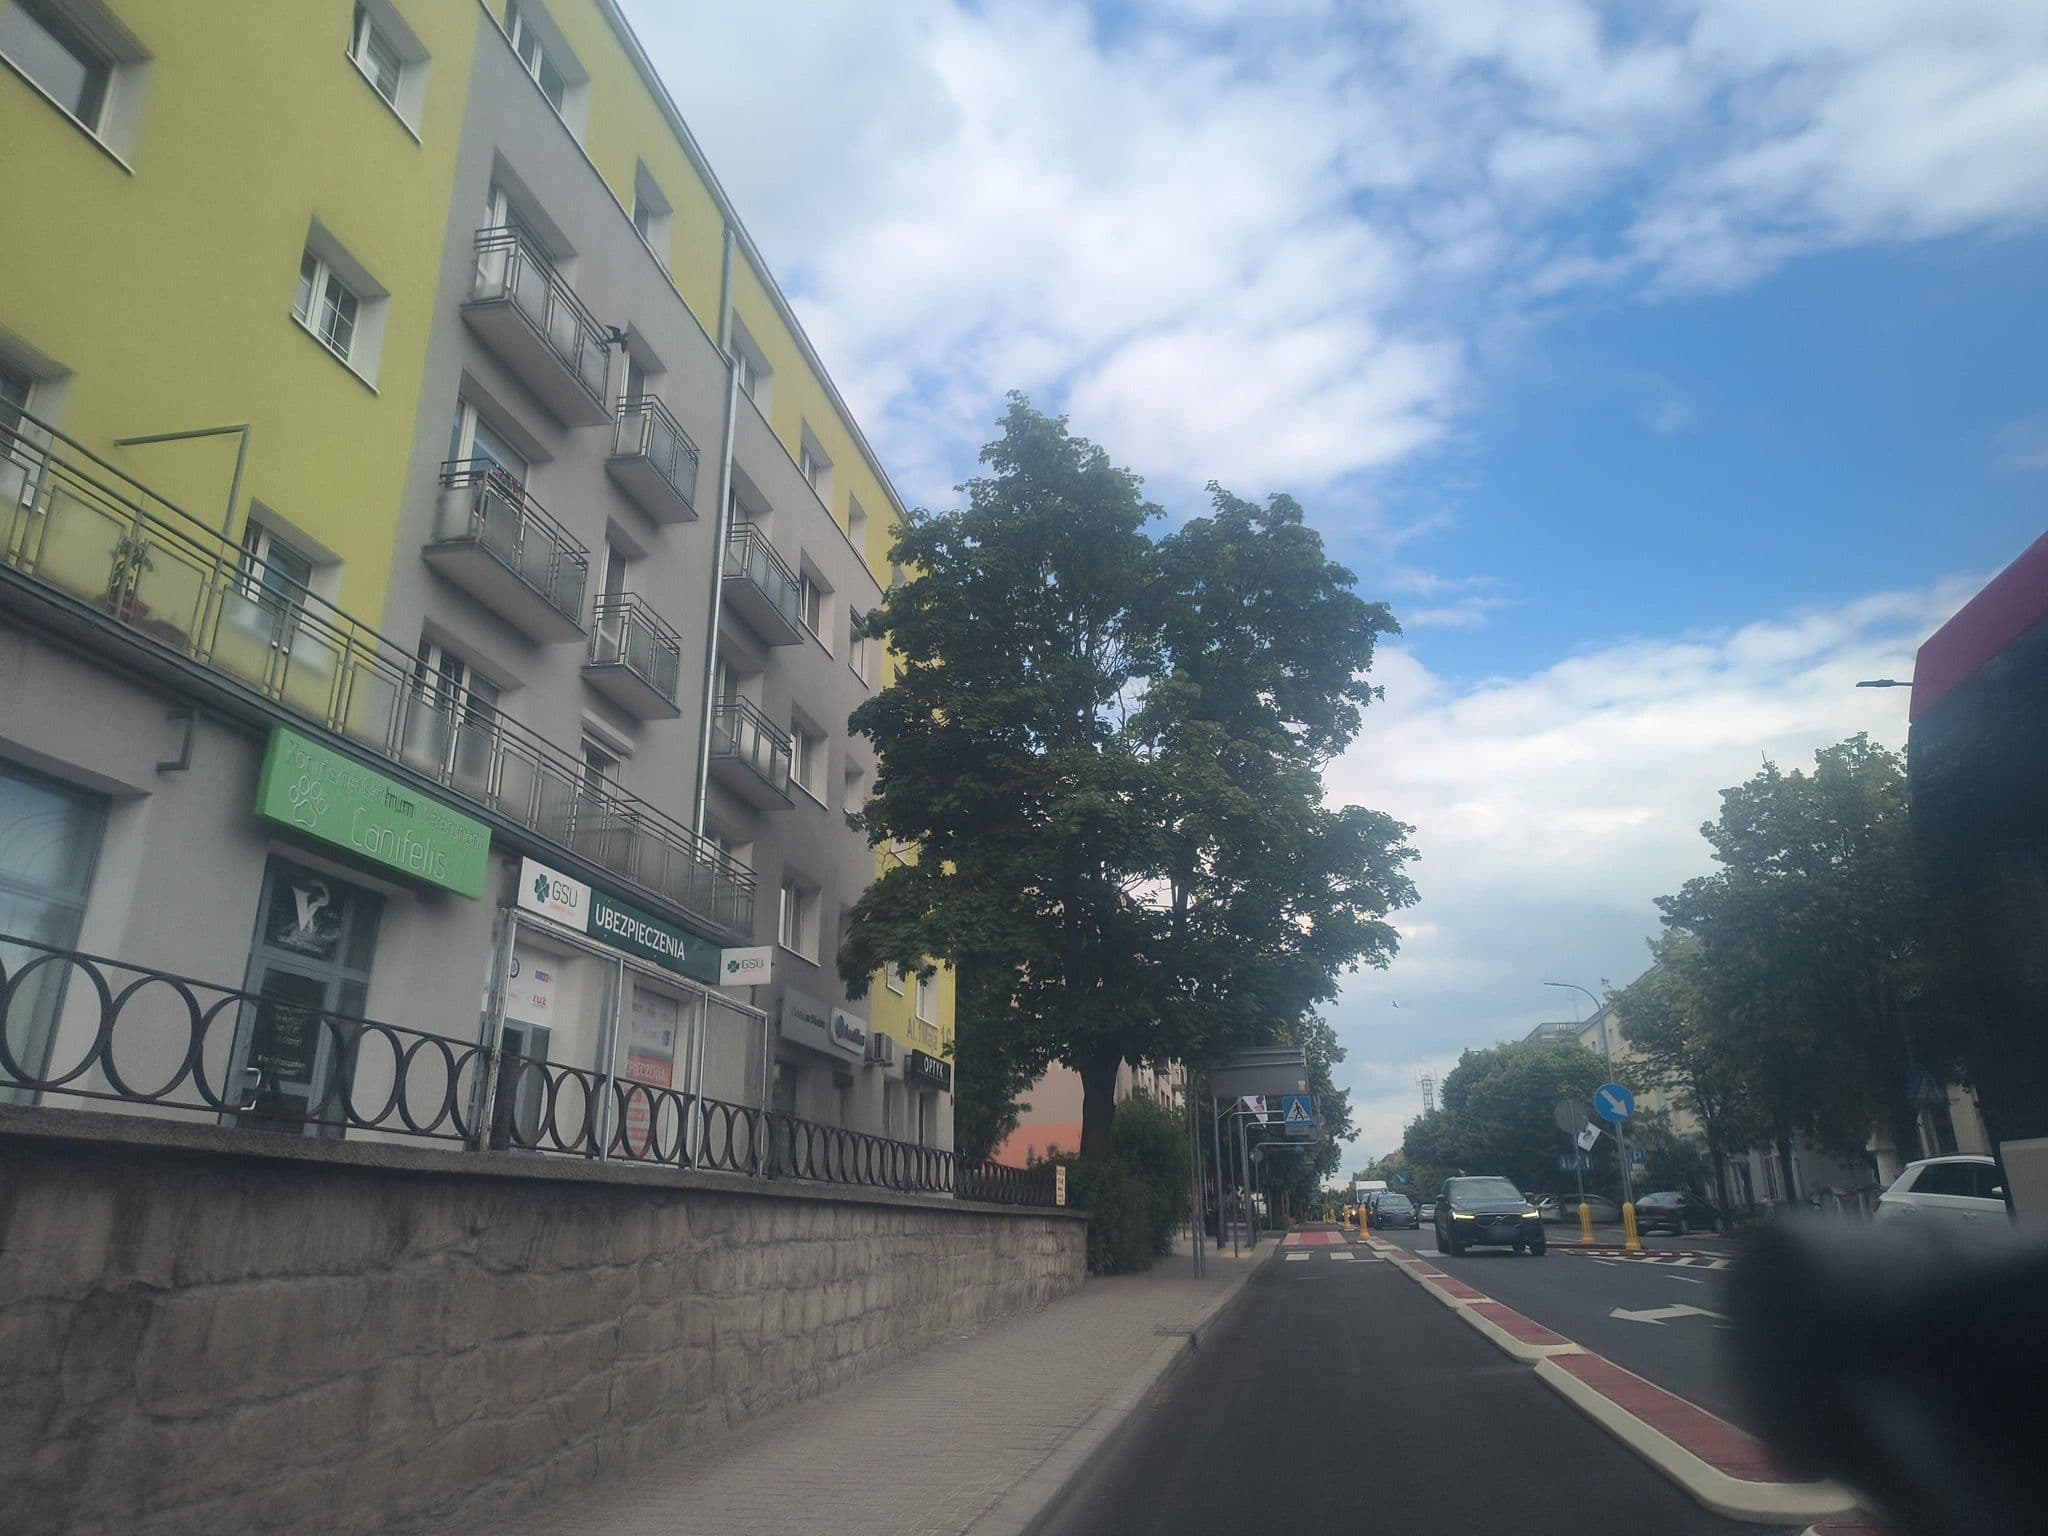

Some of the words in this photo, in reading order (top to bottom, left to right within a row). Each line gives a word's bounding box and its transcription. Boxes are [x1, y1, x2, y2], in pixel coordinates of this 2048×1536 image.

[350, 806, 448, 880] Canifelis
[552, 880, 578, 908] GSU
[594, 903, 686, 961] UBEZPIECZENIA
[741, 959, 764, 970] GSU
[923, 1056, 944, 1080] OPTYK
